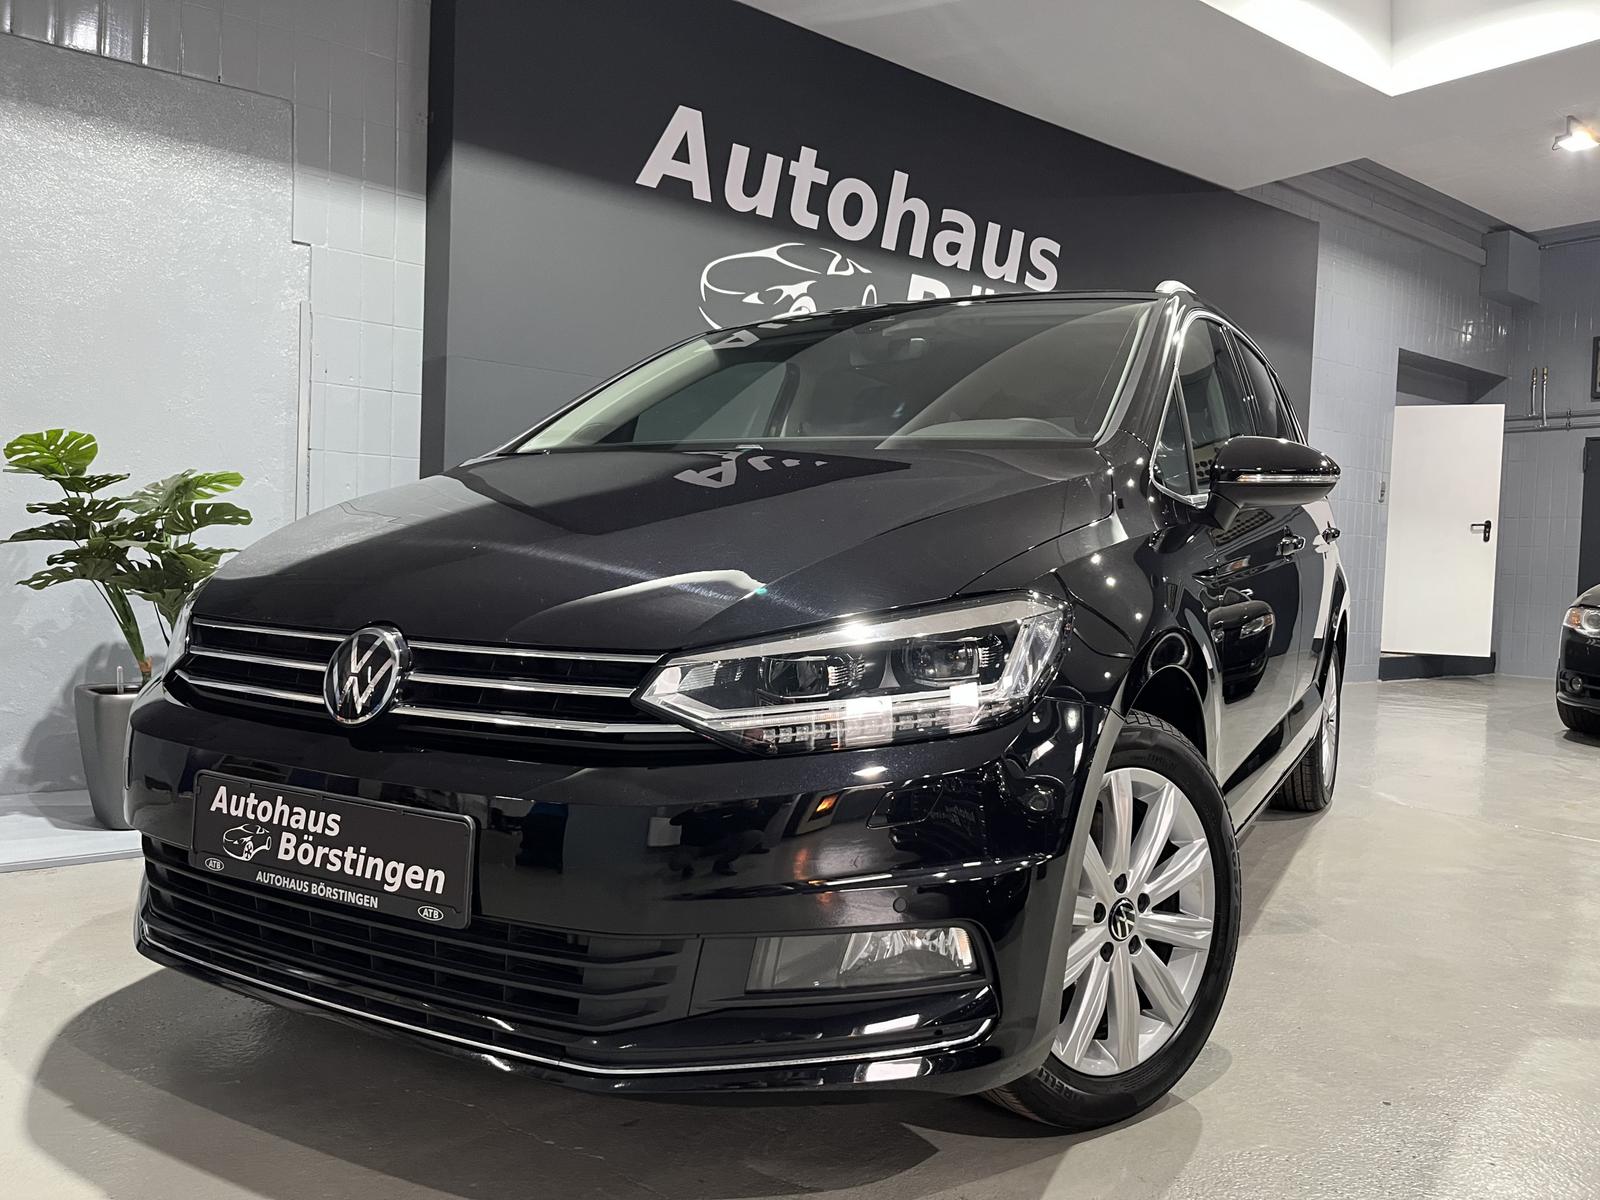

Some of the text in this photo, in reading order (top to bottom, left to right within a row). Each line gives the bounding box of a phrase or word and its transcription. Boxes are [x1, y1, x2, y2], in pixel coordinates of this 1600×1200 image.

[635, 105, 1062, 293] Autohaus
[209, 785, 342, 837] Autohaus
[208, 859, 222, 869] ATB
[277, 831, 447, 895] Börstingen
[255, 870, 379, 909] AUTOHAUS BÖRSTINGEN
[422, 908, 440, 919] ATB
